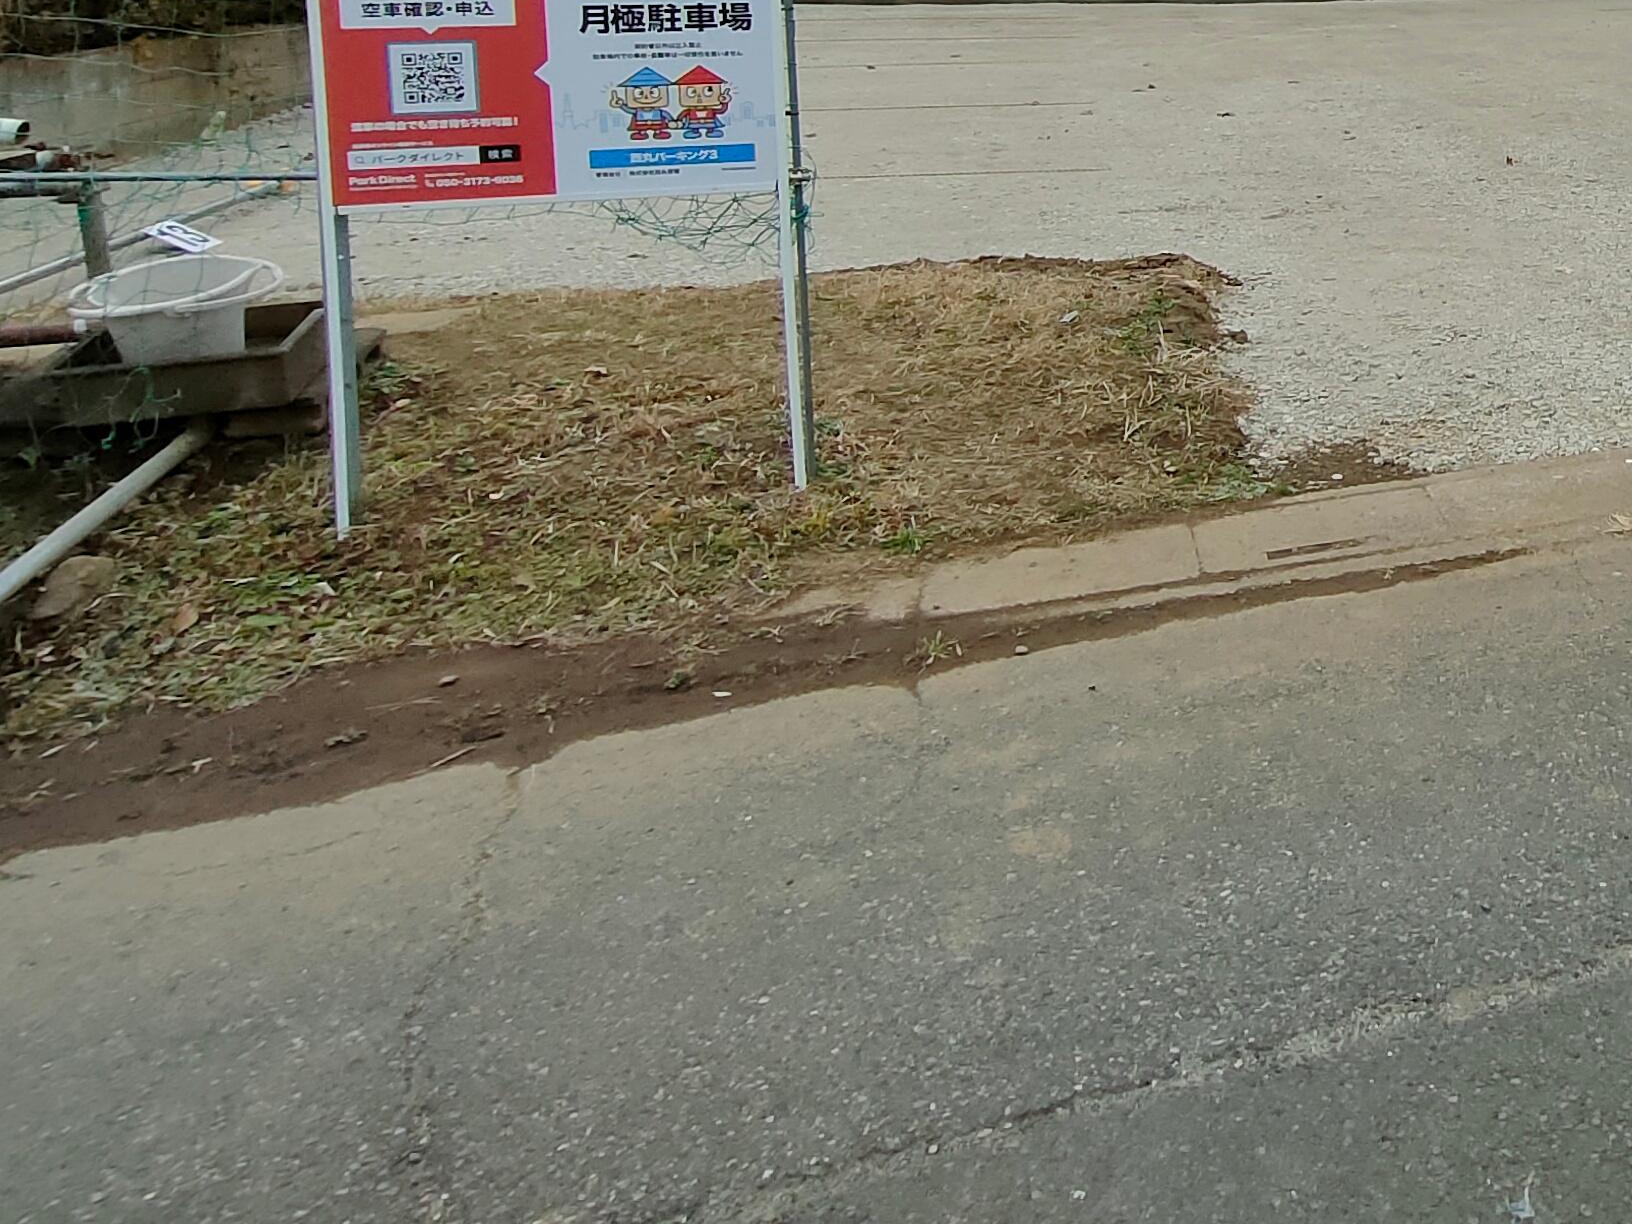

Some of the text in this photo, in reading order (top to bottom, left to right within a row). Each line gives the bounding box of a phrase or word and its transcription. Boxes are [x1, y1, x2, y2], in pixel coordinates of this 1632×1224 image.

[361, 1, 494, 18] 空車確認・申込
[579, 3, 752, 34] 月極駐車場
[371, 152, 465, 165] パークダイレクト
